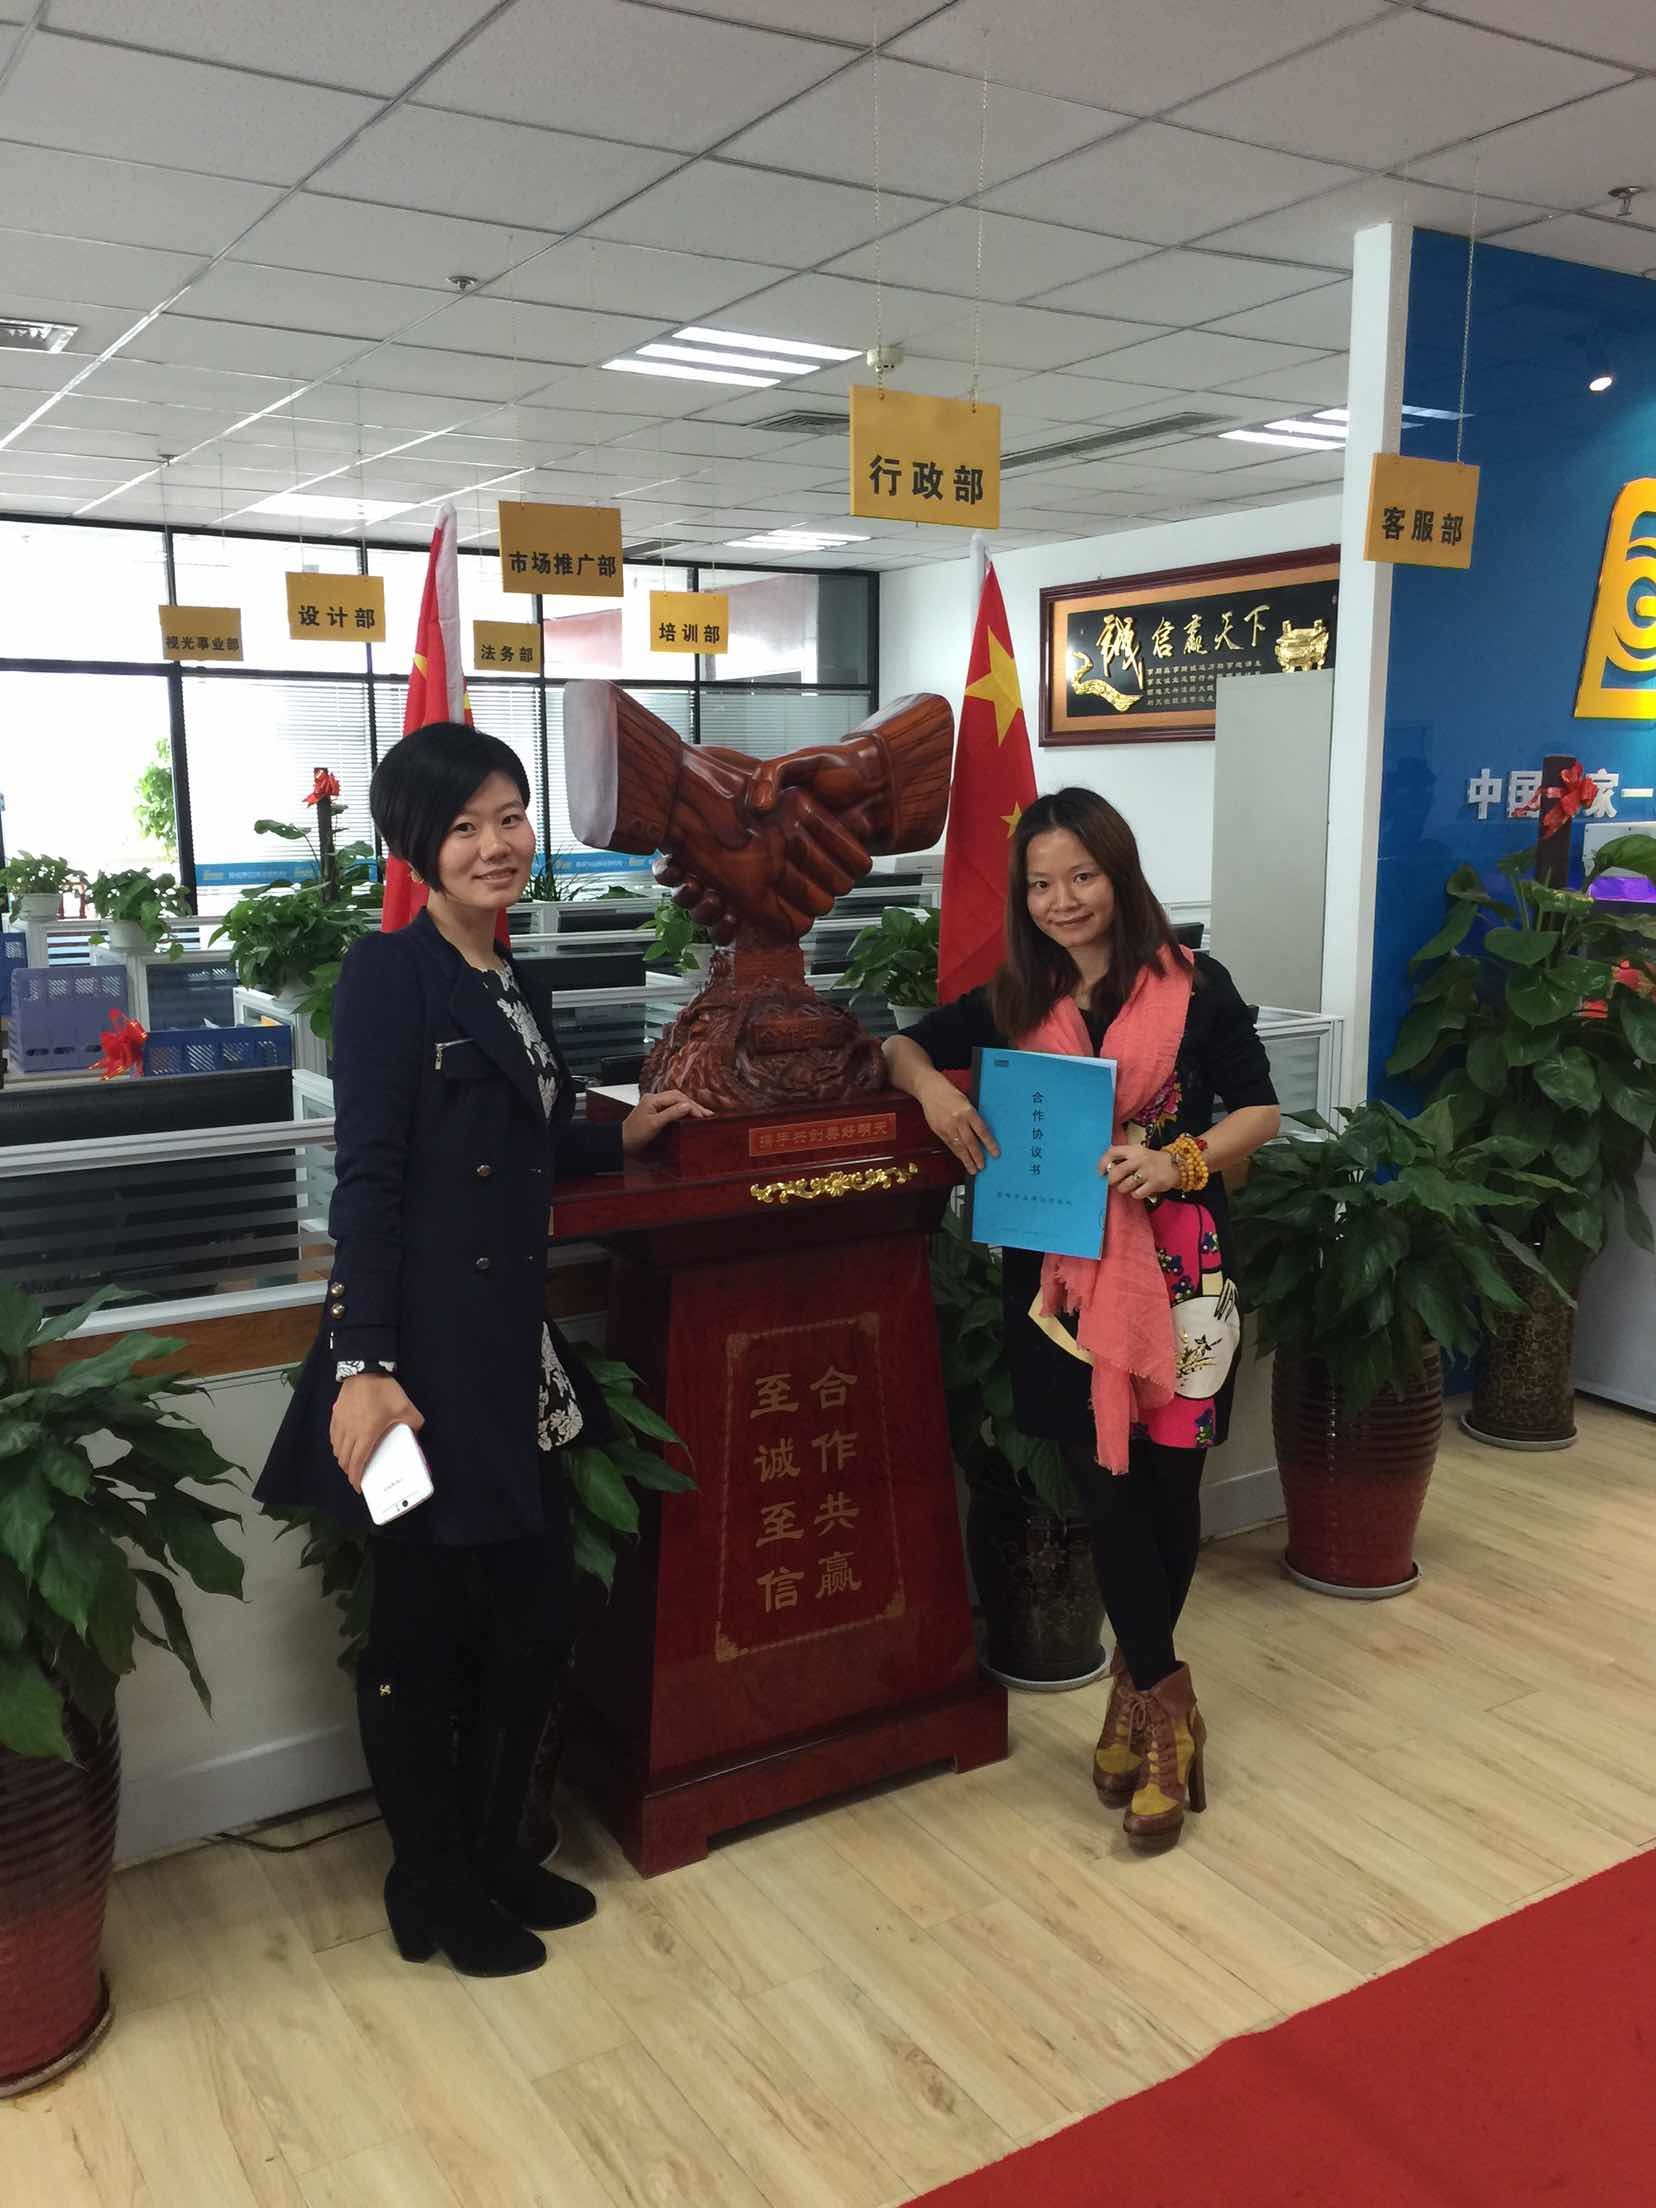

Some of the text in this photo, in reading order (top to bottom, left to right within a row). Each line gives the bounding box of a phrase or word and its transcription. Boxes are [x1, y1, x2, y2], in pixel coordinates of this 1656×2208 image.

[869, 454, 984, 505] 行政部
[1382, 506, 1464, 547] 客服部
[509, 551, 617, 579] 市场推广部
[298, 605, 376, 629] 设计部
[658, 622, 721, 645] 培训部
[480, 643, 534, 663] 法务部
[1467, 768, 1655, 820] 中国家一
[1029, 1090, 1045, 1176] 合作协议书
[750, 1372, 805, 1614] 至诚至信
[809, 1364, 863, 1600] 合作共赢
